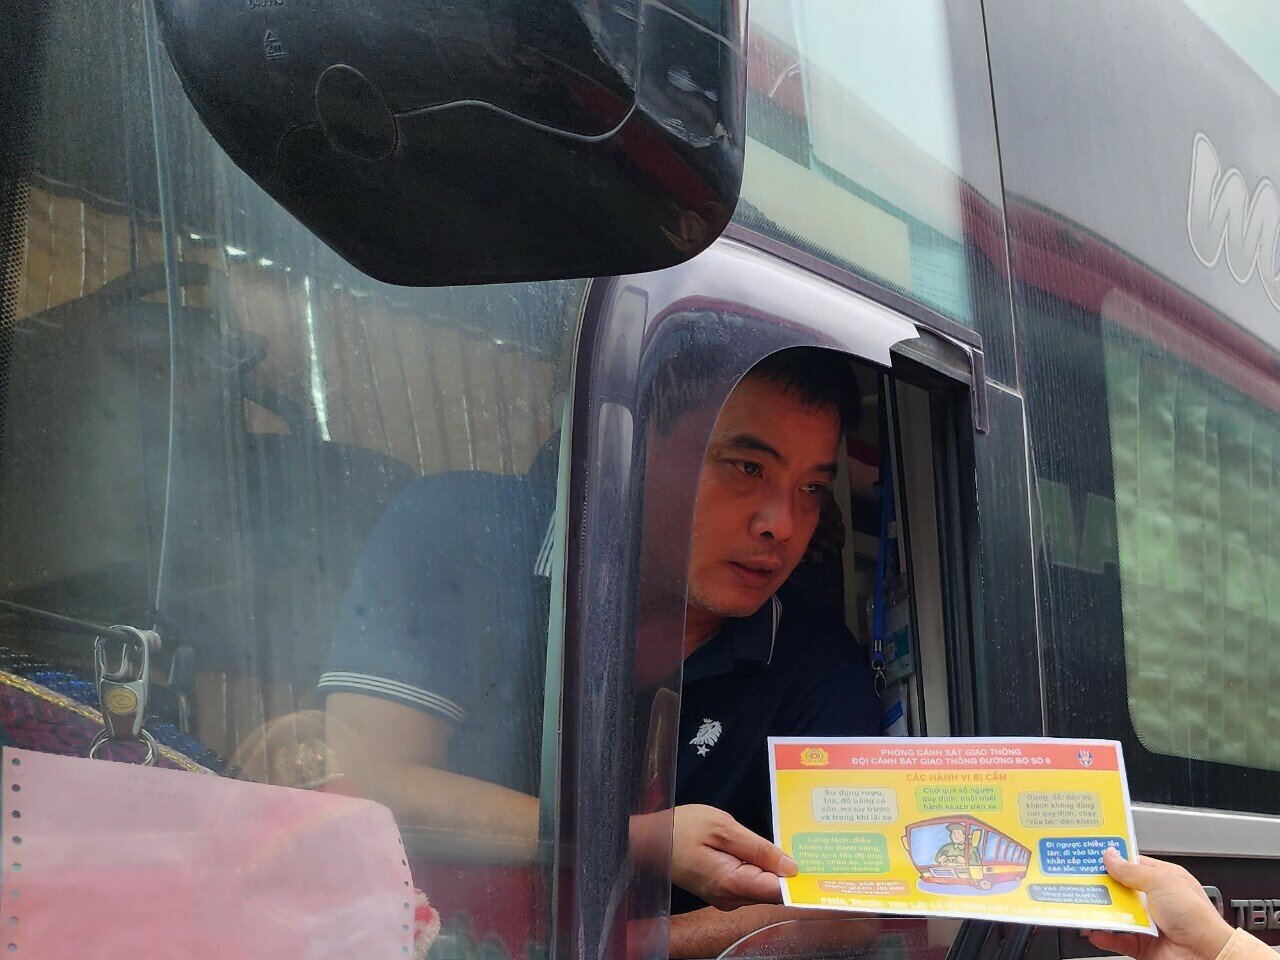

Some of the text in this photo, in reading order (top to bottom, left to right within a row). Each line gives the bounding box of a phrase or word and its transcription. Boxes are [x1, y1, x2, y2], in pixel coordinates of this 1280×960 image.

[965, 748, 988, 756] GIAO
[906, 772, 926, 781] CÁC
[930, 772, 958, 781] HÀNH
[986, 771, 1007, 781] CẤM
